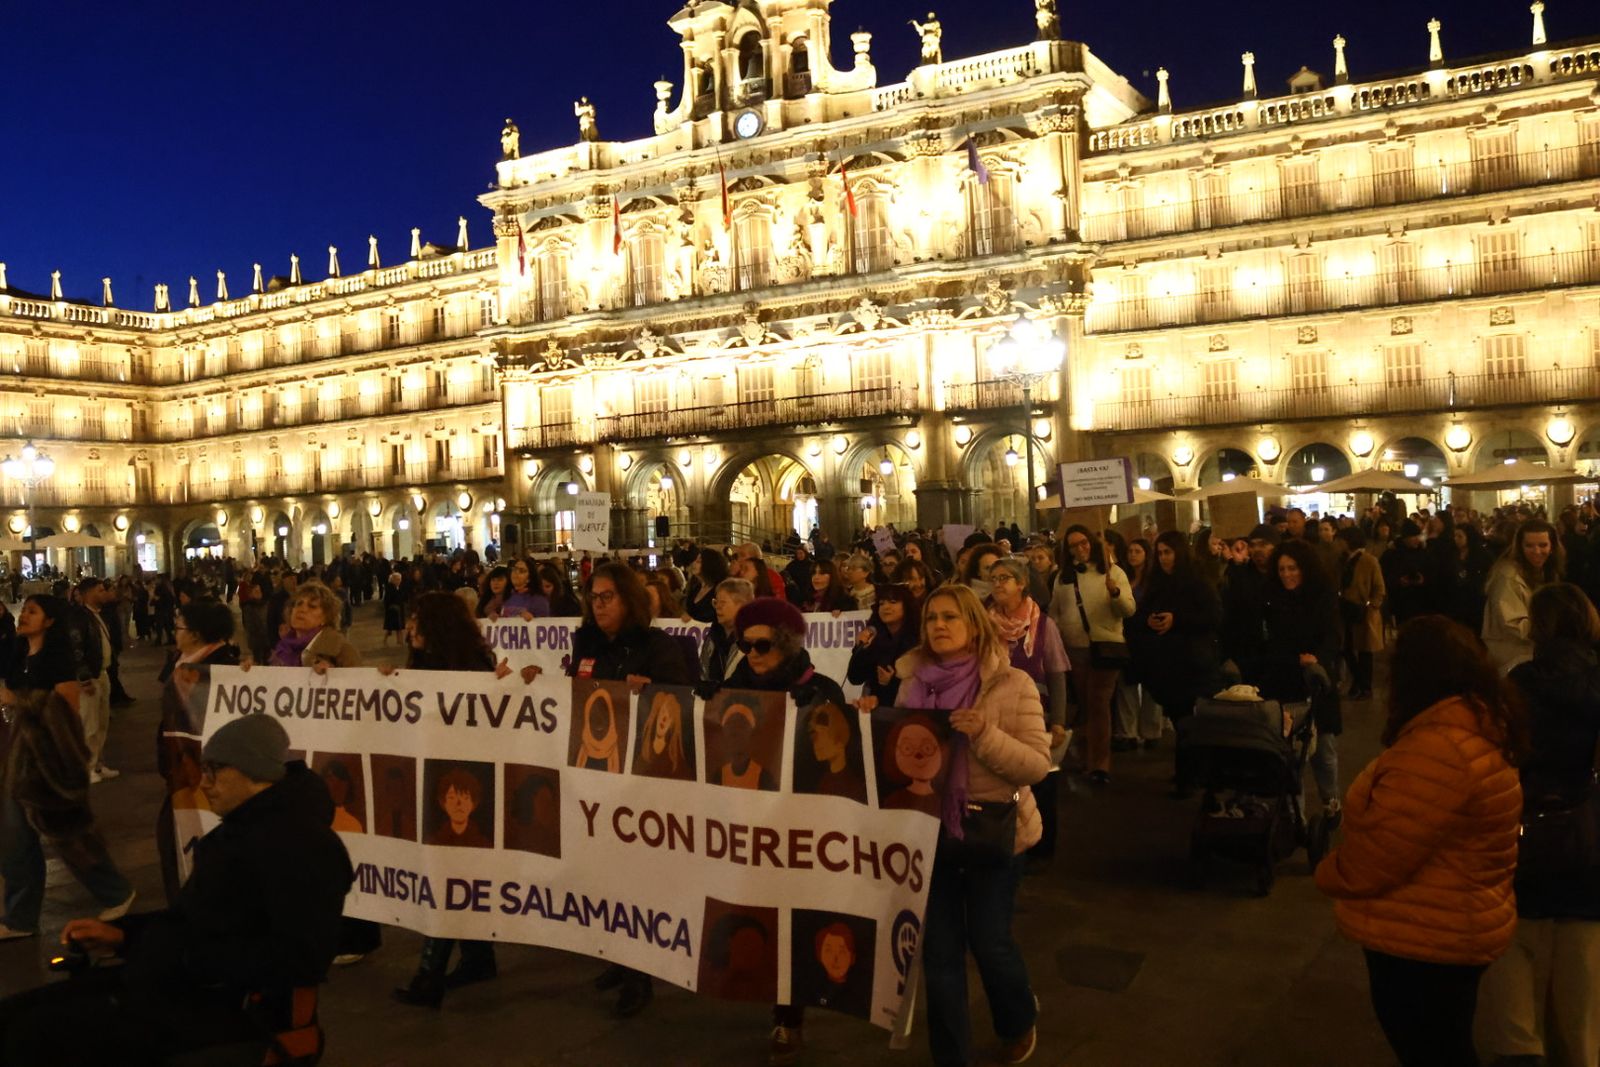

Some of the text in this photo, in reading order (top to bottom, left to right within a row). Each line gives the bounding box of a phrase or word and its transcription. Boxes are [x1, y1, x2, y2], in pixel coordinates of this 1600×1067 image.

[486, 625, 569, 650] UCHA POR
[214, 684, 558, 734] NOS QUEREMOS VIVAS
[579, 800, 924, 893] Y CON DERECHOS
[352, 862, 692, 958] MINISTA DE SALAMANCA
